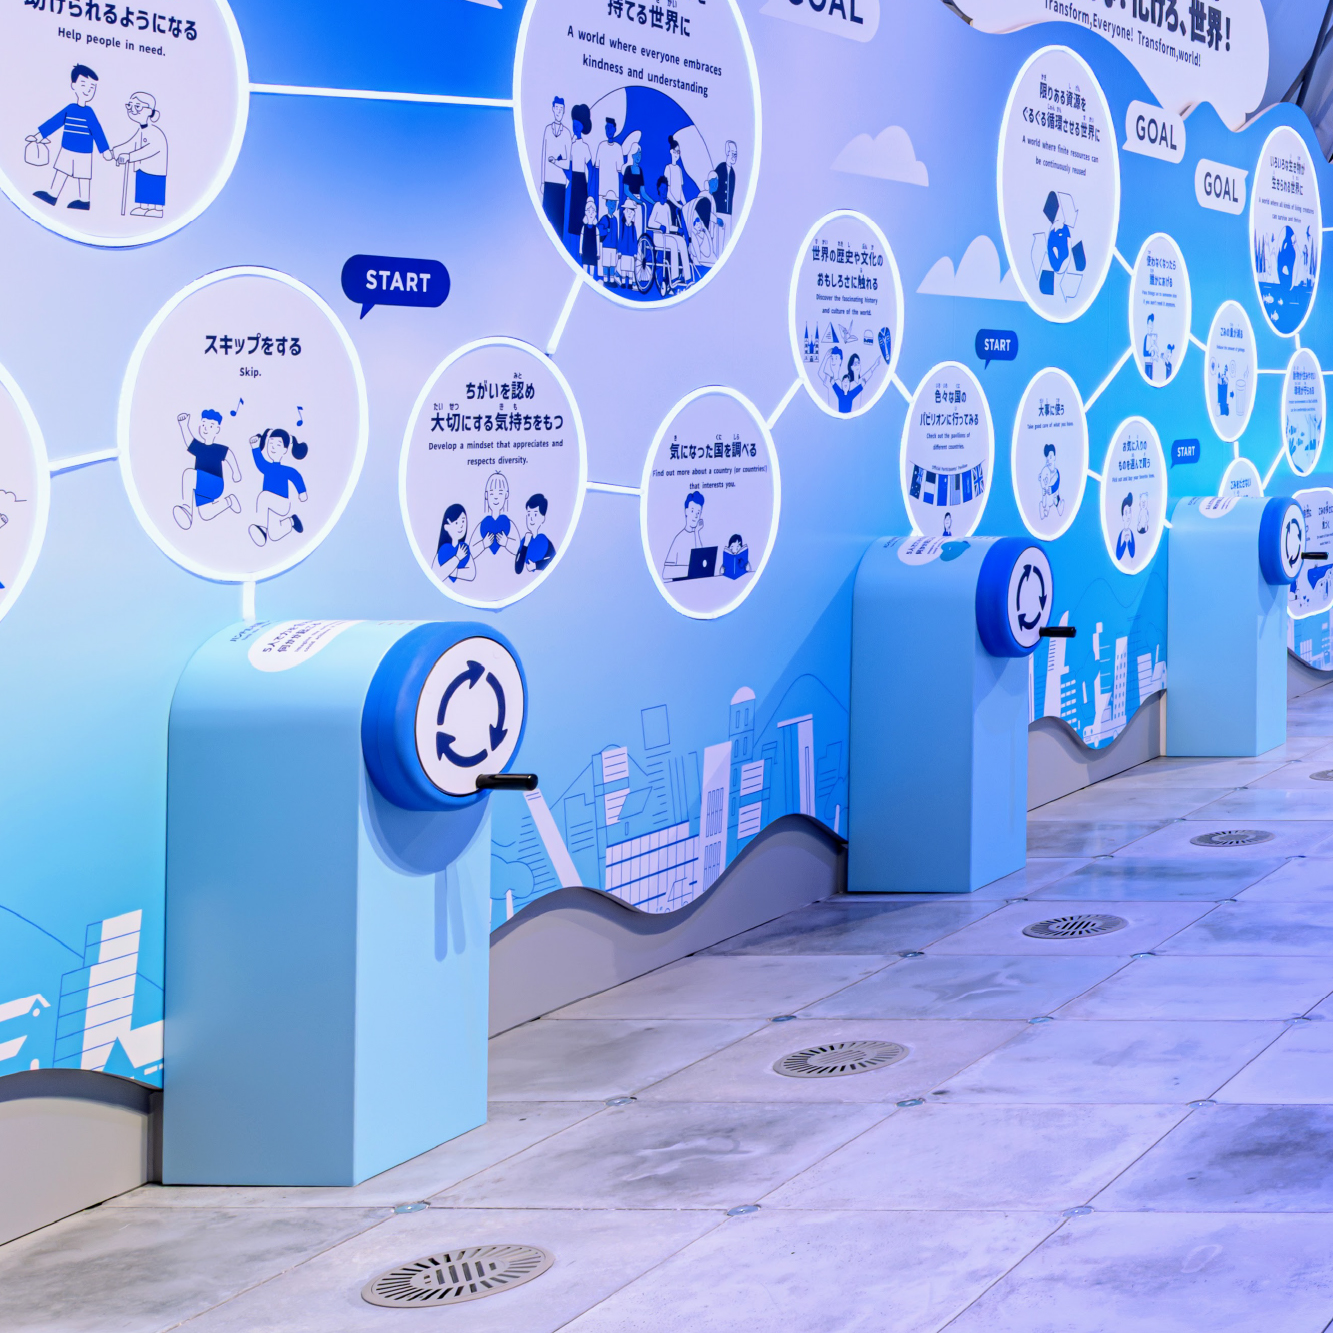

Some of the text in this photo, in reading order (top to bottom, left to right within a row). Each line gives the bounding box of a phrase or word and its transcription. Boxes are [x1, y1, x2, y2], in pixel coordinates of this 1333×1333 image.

[58, 27, 166, 56] Help people need.
[1138, 30, 1201, 67] Transform,world!
[578, 30, 722, 76] world where everyone embraces
[582, 54, 708, 98] kindness and understanding
[1039, 82, 1087, 112] 限りある資源を
[1022, 106, 1101, 142] ぐるぐる循環させる世界に
[1136, 115, 1177, 151] GOAL
[1204, 171, 1239, 203] GOAL
[812, 245, 883, 267] 世界の歴史や文化の
[365, 268, 431, 295] START
[817, 272, 878, 290] おもしろさに触れる
[204, 334, 302, 357] スキップをする
[983, 338, 1011, 352] START
[239, 366, 262, 379] Skip.
[465, 380, 535, 400] ちがいを認め
[935, 389, 967, 404] 色々な国の
[920, 412, 979, 426] パビリオンに行ってみる
[1038, 404, 1065, 417] 大事に使う
[430, 412, 563, 432] 大切にする気持ちをもつ
[428, 439, 549, 452] Develop mindset appreciates
[669, 441, 757, 460] 気になった国を調べる
[1177, 445, 1195, 458] START
[467, 456, 528, 466] respects diversity.
